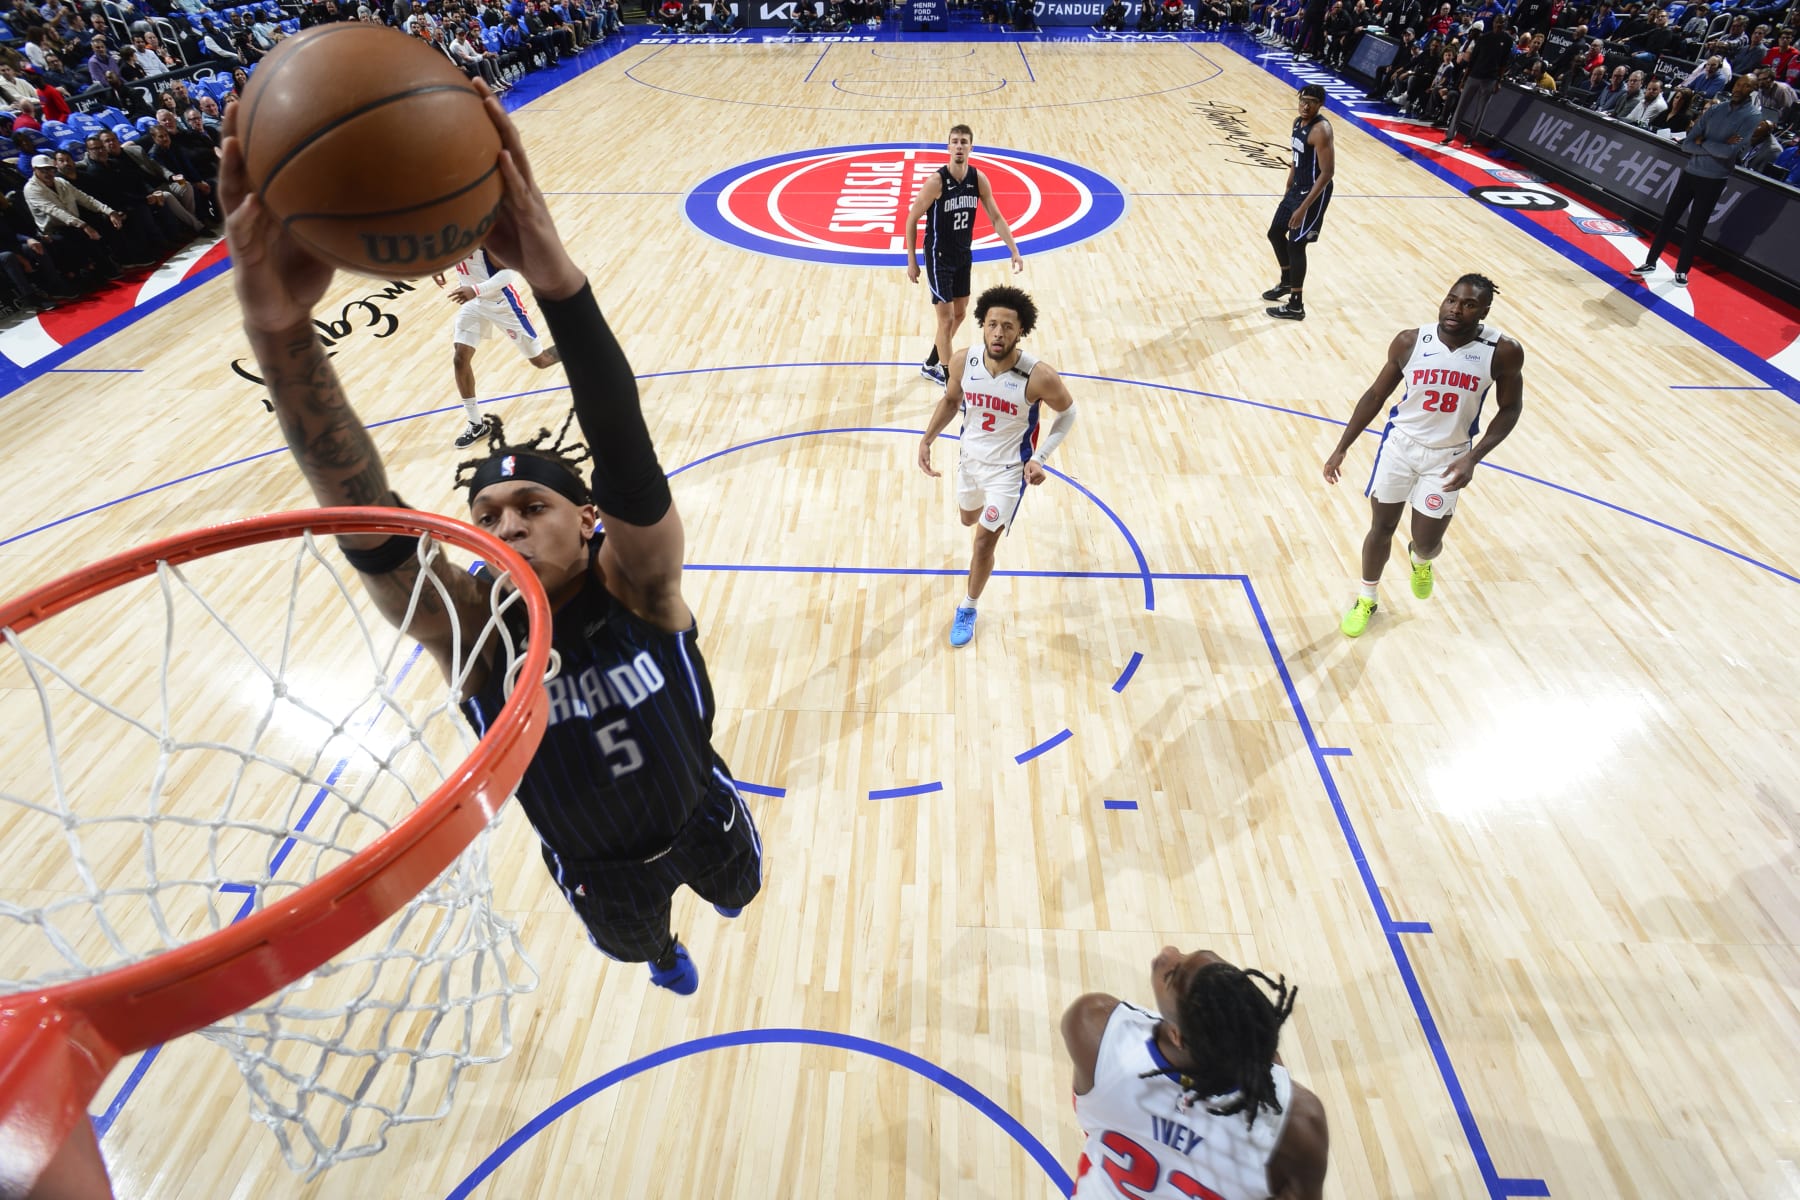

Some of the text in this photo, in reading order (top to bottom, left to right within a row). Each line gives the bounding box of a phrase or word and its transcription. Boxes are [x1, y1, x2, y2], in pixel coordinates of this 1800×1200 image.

[1048, 4, 1104, 15] FANDUEL
[1275, 62, 1381, 107] FANDUEL
[1529, 112, 1741, 223] WE ARE HENY
[828, 161, 904, 233] PISTONS
[944, 196, 978, 212] ORLANDO
[1480, 191, 1556, 206] 6
[358, 201, 500, 264] Wilso
[953, 211, 969, 230] 22
[1412, 369, 1480, 392] PISTONS
[965, 391, 1018, 416] PISTONS
[1423, 390, 1459, 413] 28
[981, 413, 996, 432] 2
[596, 718, 644, 779] 5
[1151, 1115, 1204, 1156] IVEY
